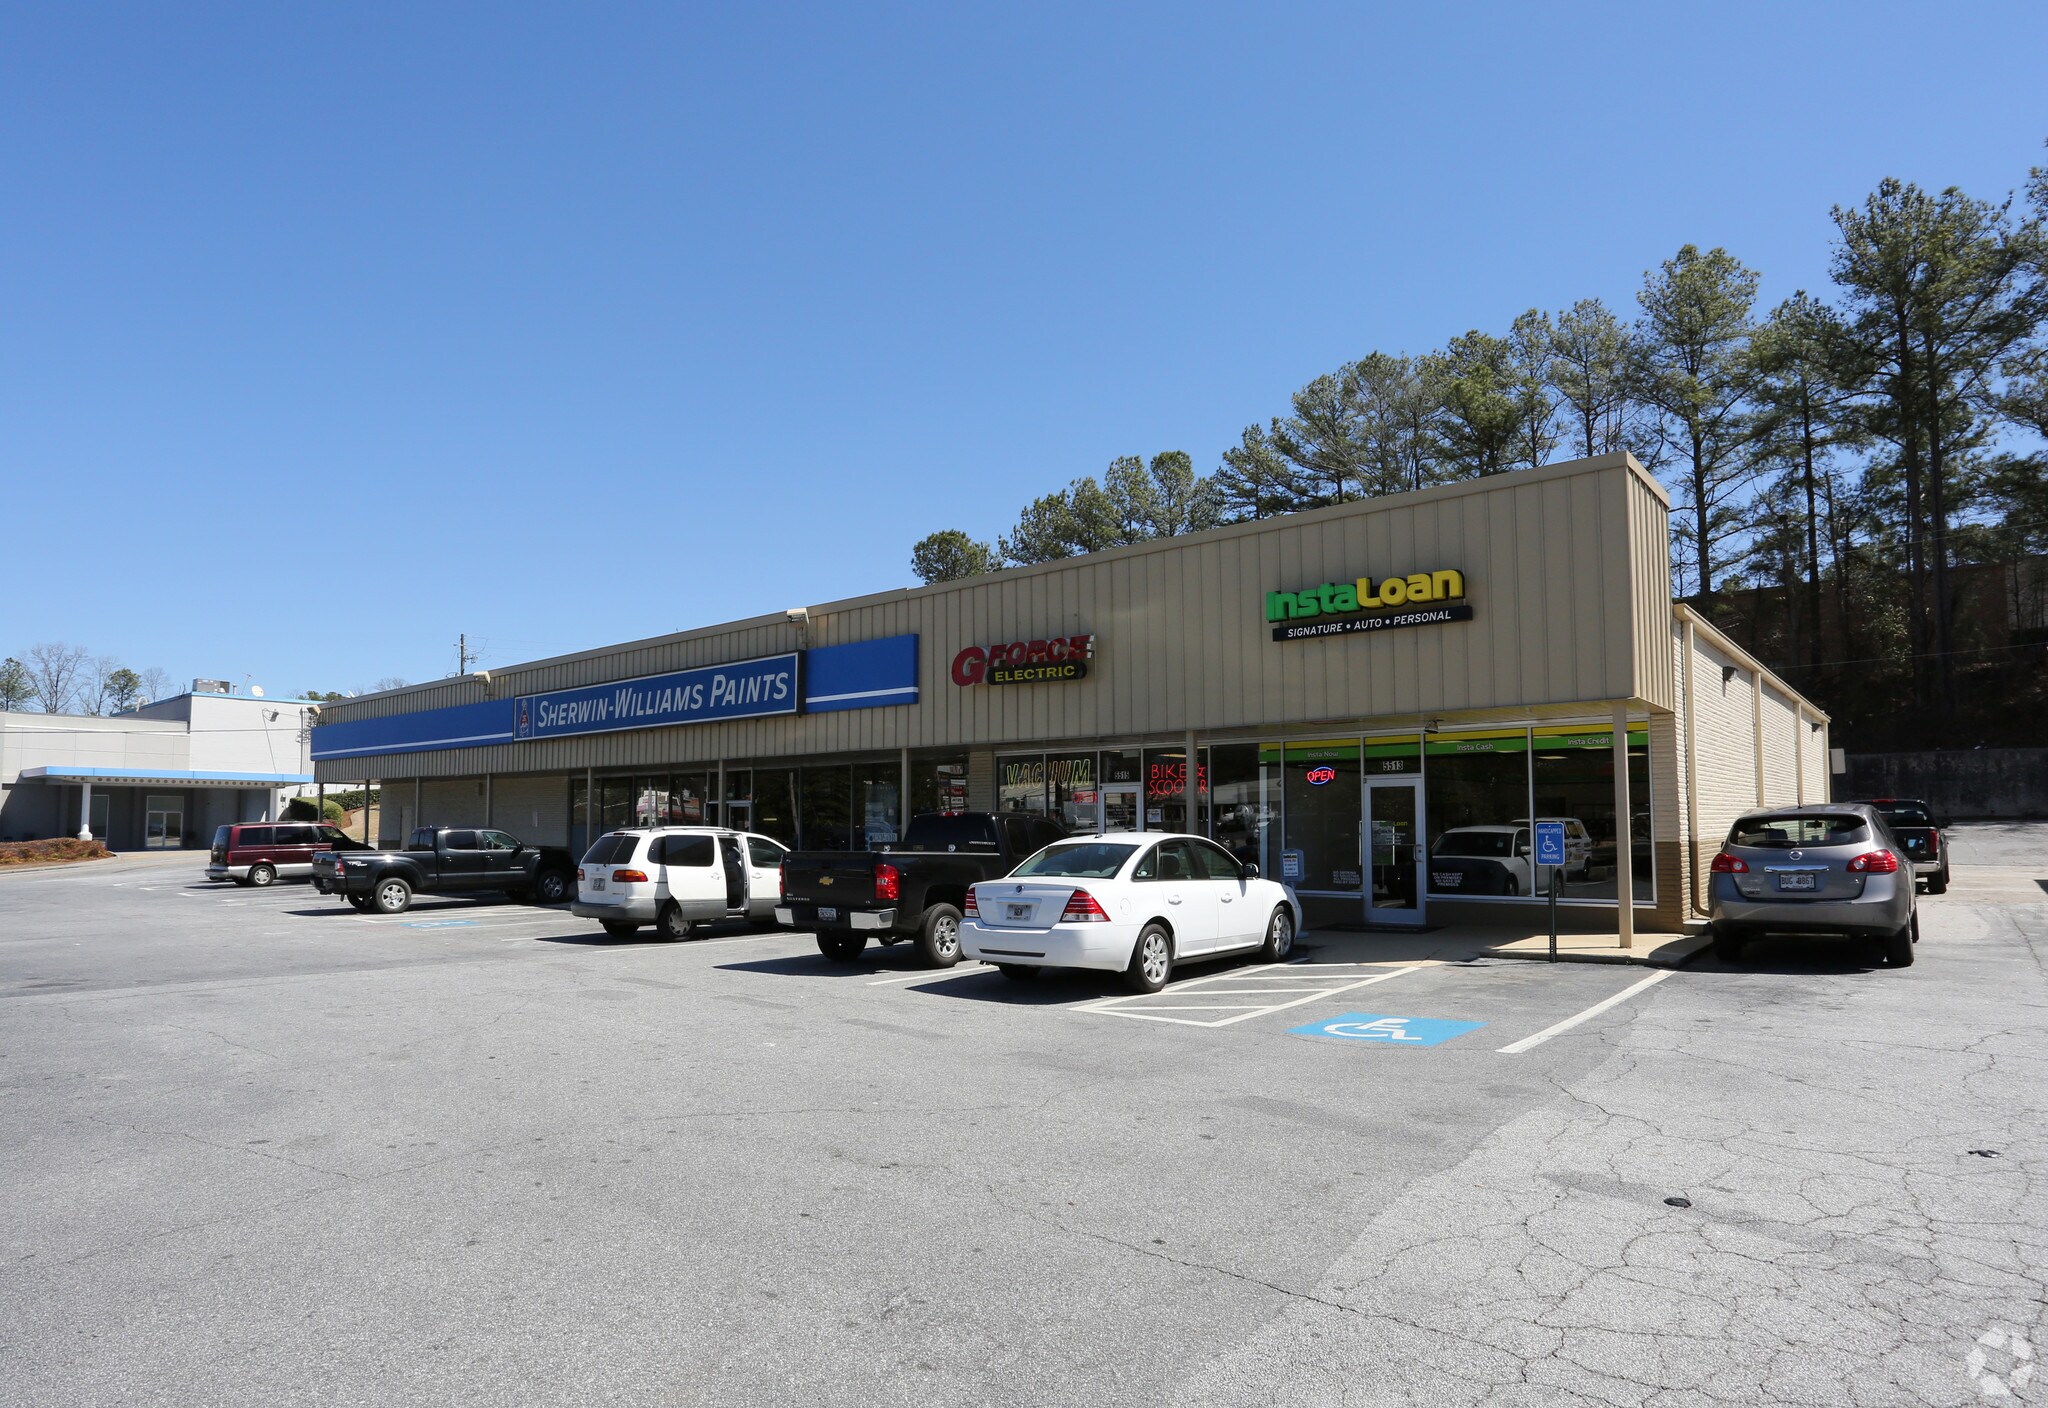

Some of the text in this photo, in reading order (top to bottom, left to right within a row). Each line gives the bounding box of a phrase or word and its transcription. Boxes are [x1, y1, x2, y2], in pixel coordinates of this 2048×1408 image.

[1266, 569, 1464, 621] InstaLoan
[1288, 610, 1452, 637] SIGNATURE AUTO PERSONAL
[995, 665, 1075, 682] ELECTRIC
[538, 672, 788, 727] SHERWIN-WILLIAMS PAINTS
[1006, 759, 1090, 789] VACUUM
[1151, 764, 1187, 779] BIKE
[1383, 760, 1403, 771] 5513
[1306, 769, 1335, 783] OPEN
[1149, 779, 1209, 795] SCOOR
